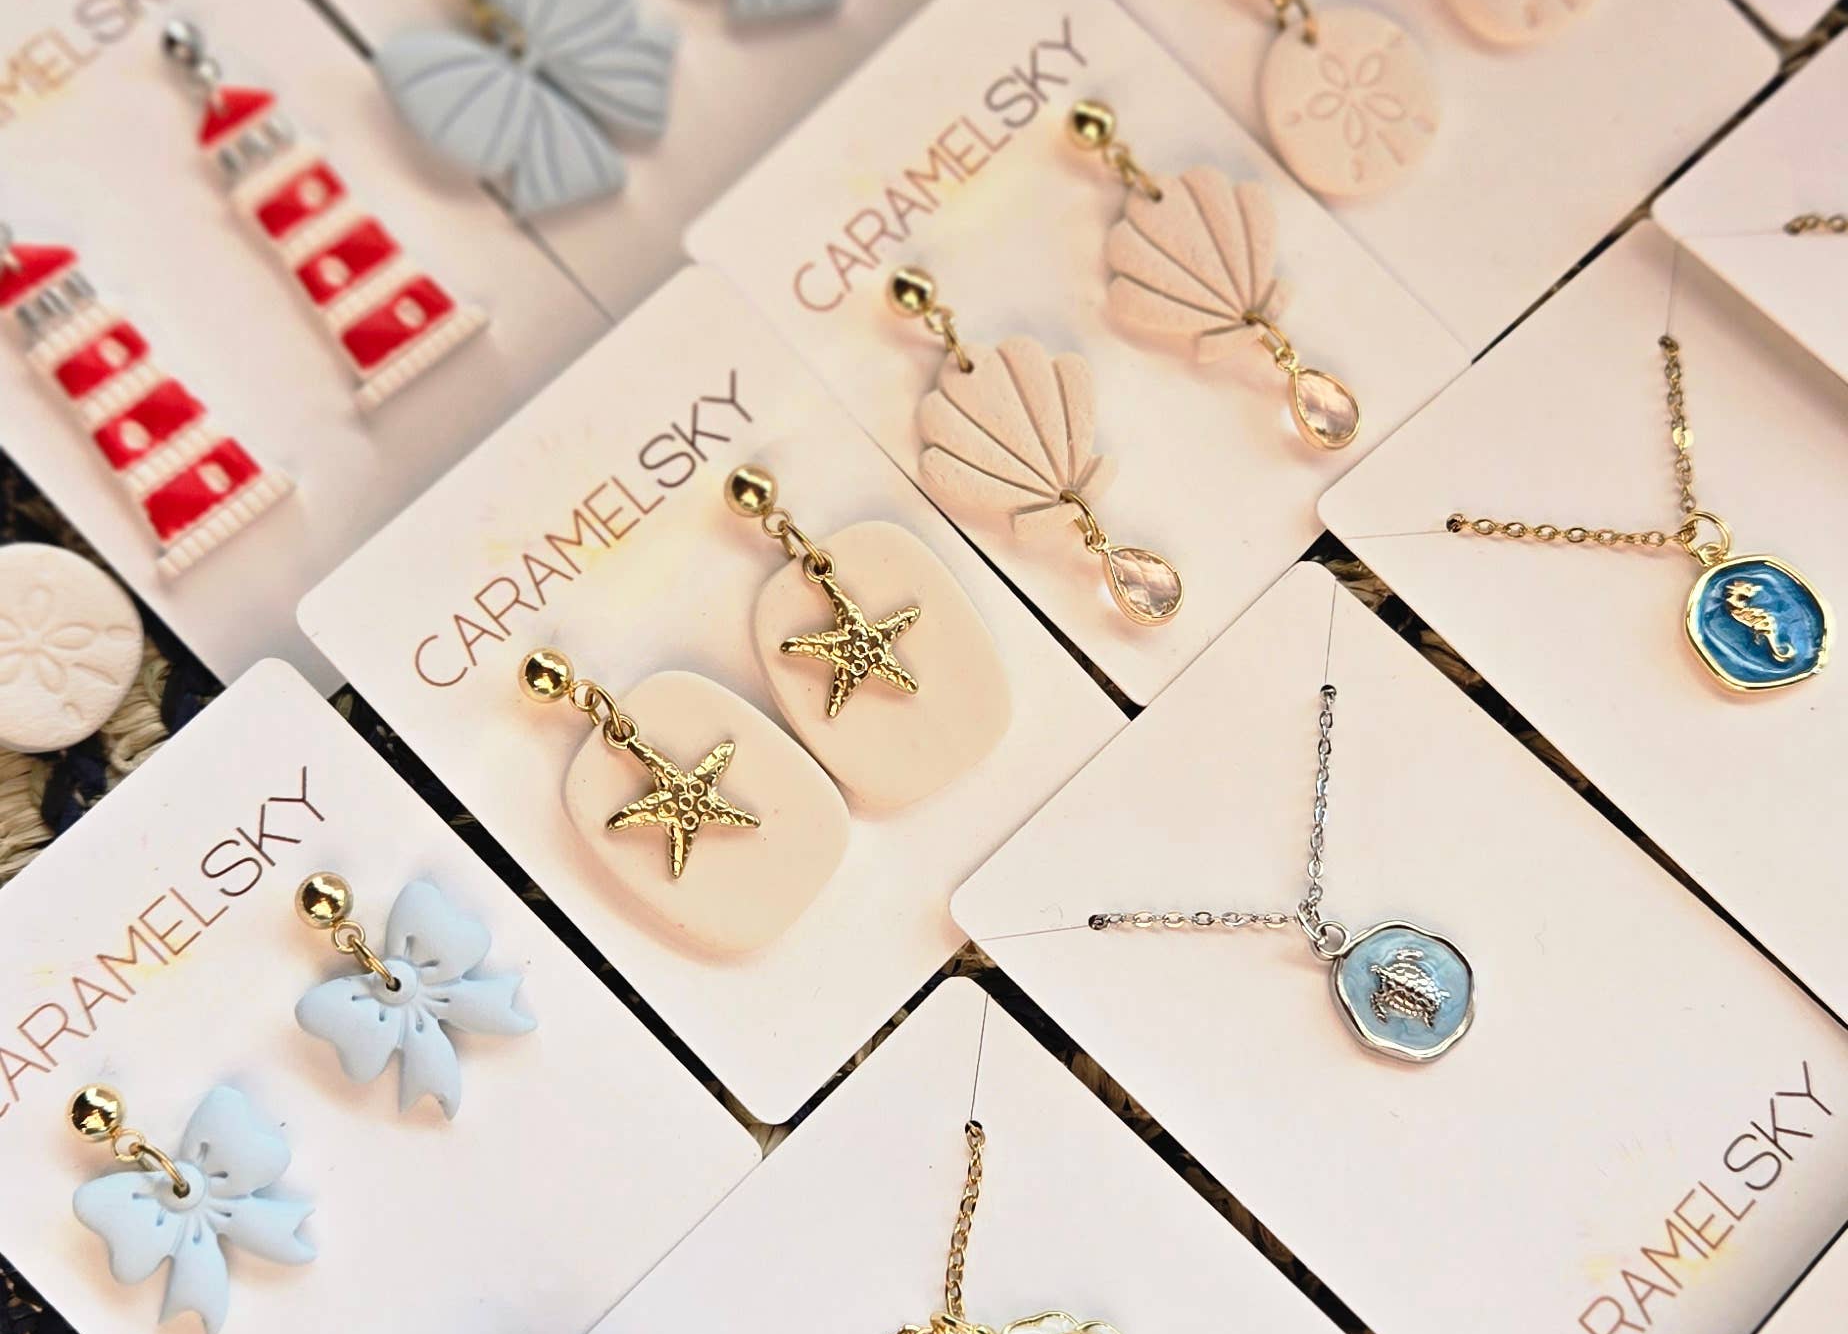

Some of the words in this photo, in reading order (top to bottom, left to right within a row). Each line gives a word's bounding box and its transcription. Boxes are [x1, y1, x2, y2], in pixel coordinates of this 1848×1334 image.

[793, 15, 1088, 313] CARAMELSKY
[414, 368, 753, 688] CARAMELSKY
[0, 765, 326, 1117] ARAMELSKY
